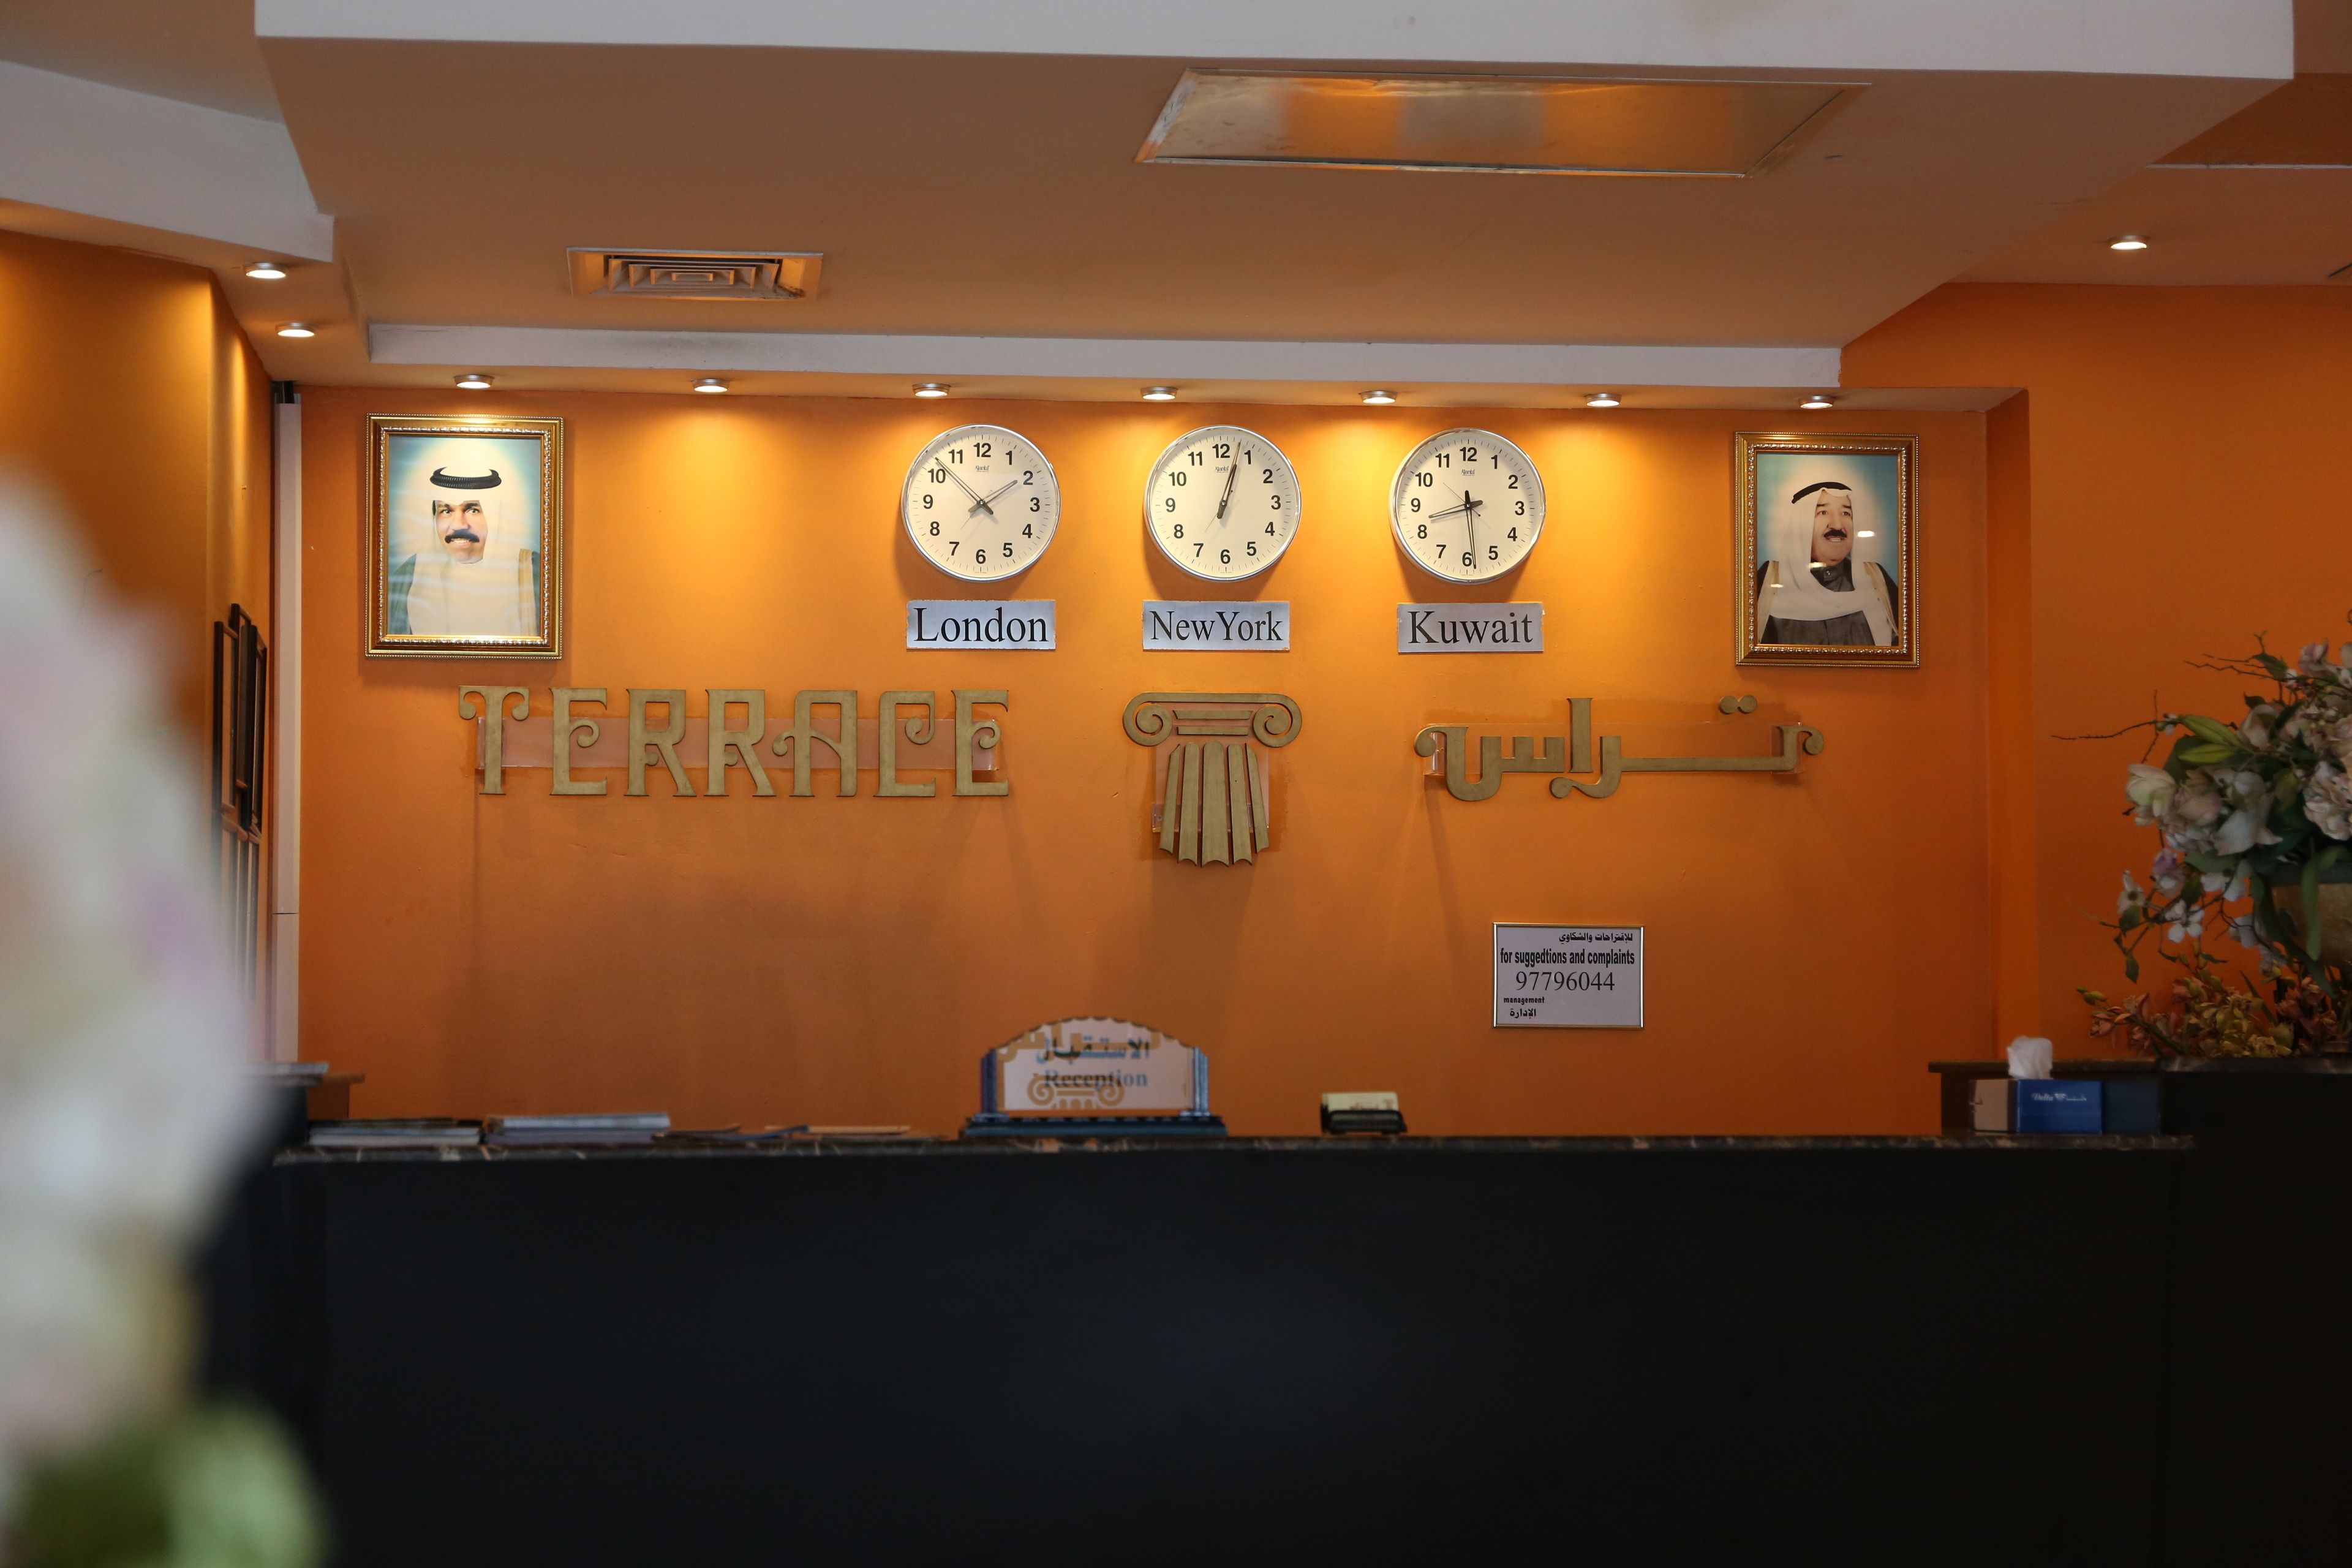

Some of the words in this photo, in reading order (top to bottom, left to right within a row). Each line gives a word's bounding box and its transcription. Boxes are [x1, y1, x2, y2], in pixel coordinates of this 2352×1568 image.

[948, 449, 963, 464] 11
[974, 442, 992, 458] 12
[1212, 443, 1231, 459] 12
[1244, 450, 1251, 465] 1
[1460, 447, 1477, 462] 12
[1006, 450, 1012, 466] 1
[1188, 451, 1202, 466] 11
[1435, 453, 1450, 468] 11
[1491, 454, 1498, 470] 1
[928, 468, 946, 483] 10
[1023, 470, 1033, 486] 2
[1169, 472, 1186, 486] 10
[1263, 469, 1273, 484] 2
[1415, 472, 1433, 488] 10
[1508, 474, 1518, 489] 2
[923, 494, 933, 510] 9
[1030, 497, 1040, 512] 3
[1166, 497, 1175, 513] 9
[1271, 495, 1281, 510] 3
[1411, 498, 1421, 513] 9
[1515, 500, 1525, 516] 3
[930, 521, 940, 537] 8
[1022, 523, 1033, 538] 4
[1174, 524, 1184, 539] 8
[1265, 521, 1275, 537] 4
[1417, 524, 1428, 539] 8
[1507, 527, 1518, 542] 4
[949, 541, 960, 556] 7
[1003, 542, 1013, 557] 5
[1193, 543, 1204, 557] 7
[1246, 541, 1257, 556] 5
[1436, 544, 1447, 559] 7
[1488, 545, 1498, 560] 5
[976, 549, 986, 564] 6
[1220, 549, 1231, 564] 6
[1462, 551, 1472, 567] 6
[913, 606, 1049, 643] London
[1408, 611, 1533, 644] Kuwait
[458, 685, 1010, 797] TERRACE
[1500, 948, 1513, 964] for
[1515, 948, 1567, 968] suggedtions
[1569, 948, 1585, 964] and
[1587, 948, 1635, 968] complaints
[1516, 971, 1615, 991] 97796044
[1503, 996, 1545, 1006] management
[1509, 1008, 1537, 1019] الإدارة
[1044, 1069, 1148, 1091] Reception
